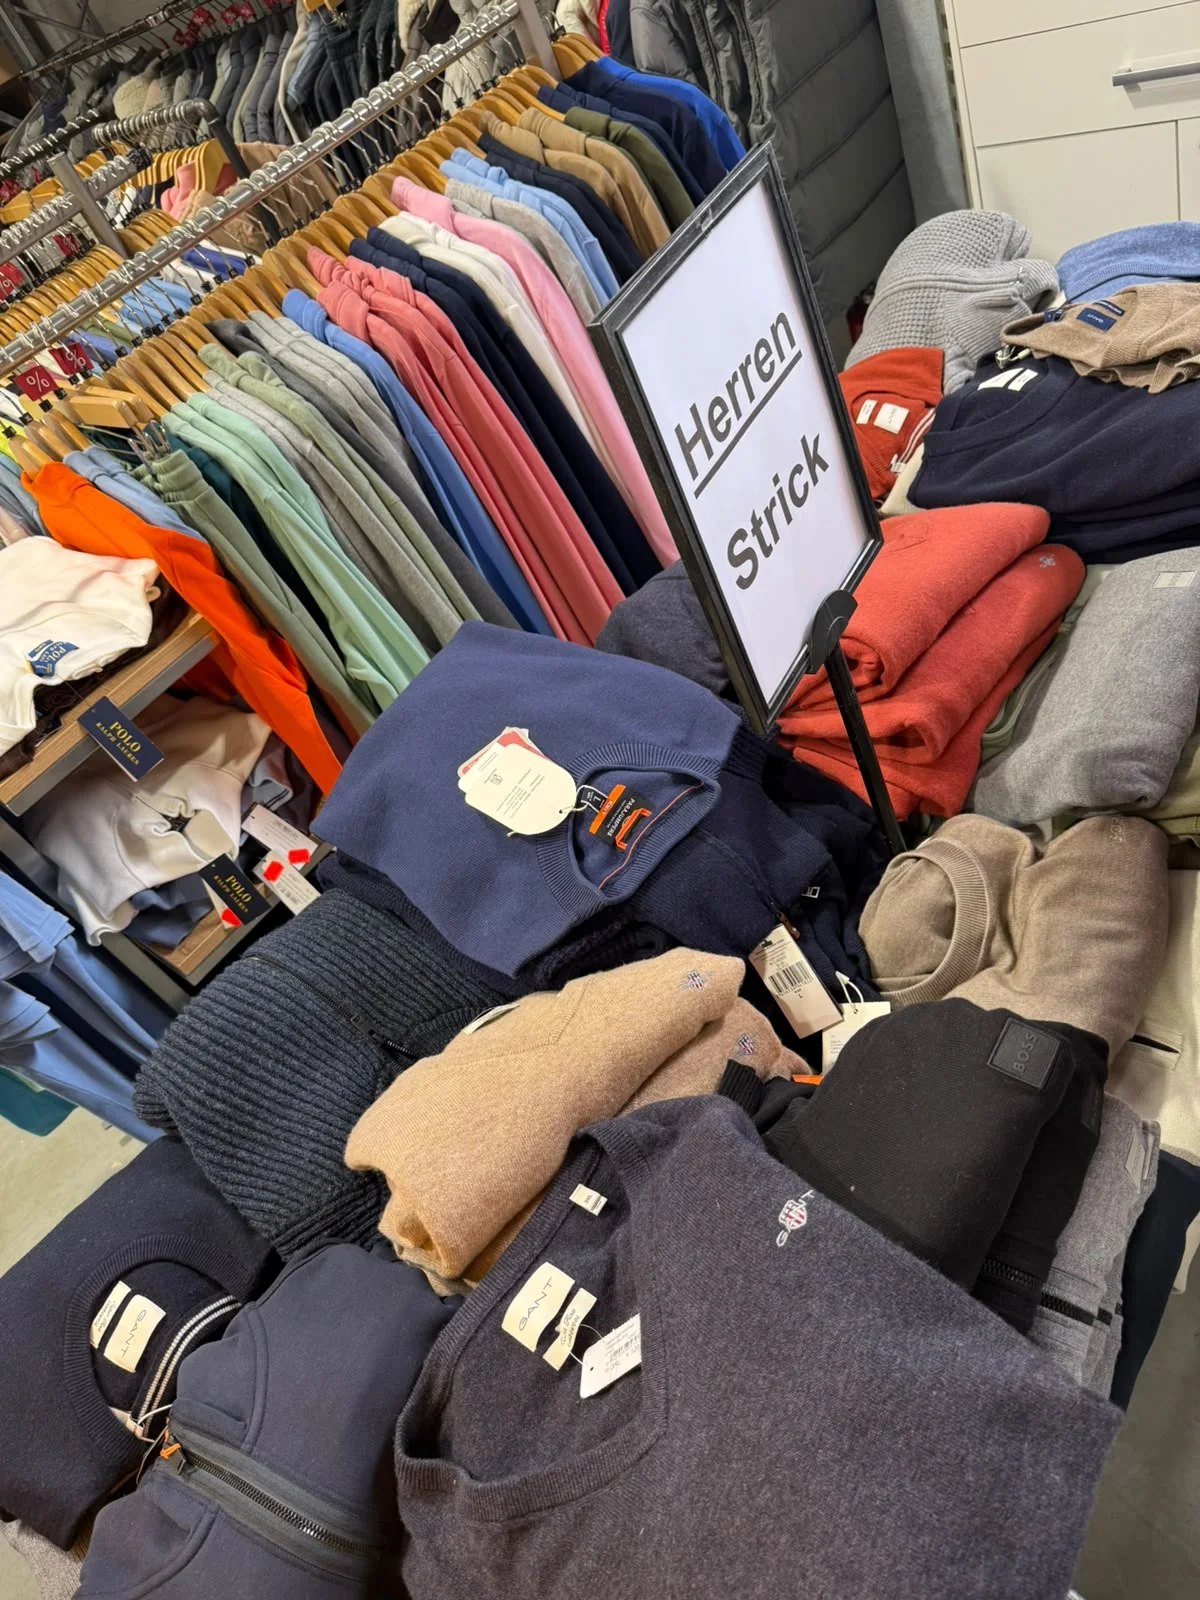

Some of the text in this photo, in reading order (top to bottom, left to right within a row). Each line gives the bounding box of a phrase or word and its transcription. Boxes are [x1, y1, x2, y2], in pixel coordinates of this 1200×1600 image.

[26, 370, 50, 393] %
[674, 312, 797, 482] Herren
[727, 433, 830, 591] Strick
[95, 721, 117, 743] RALPH
[110, 721, 141, 753] POLO
[116, 742, 140, 766] LAUREN
[607, 797, 635, 837] PARAJUMPERS
[225, 875, 252, 902] POLO
[1012, 1031, 1038, 1073] BOSS
[776, 1189, 815, 1247] GANT
[518, 1277, 553, 1332] GANT
[121, 1309, 148, 1358] GANT
